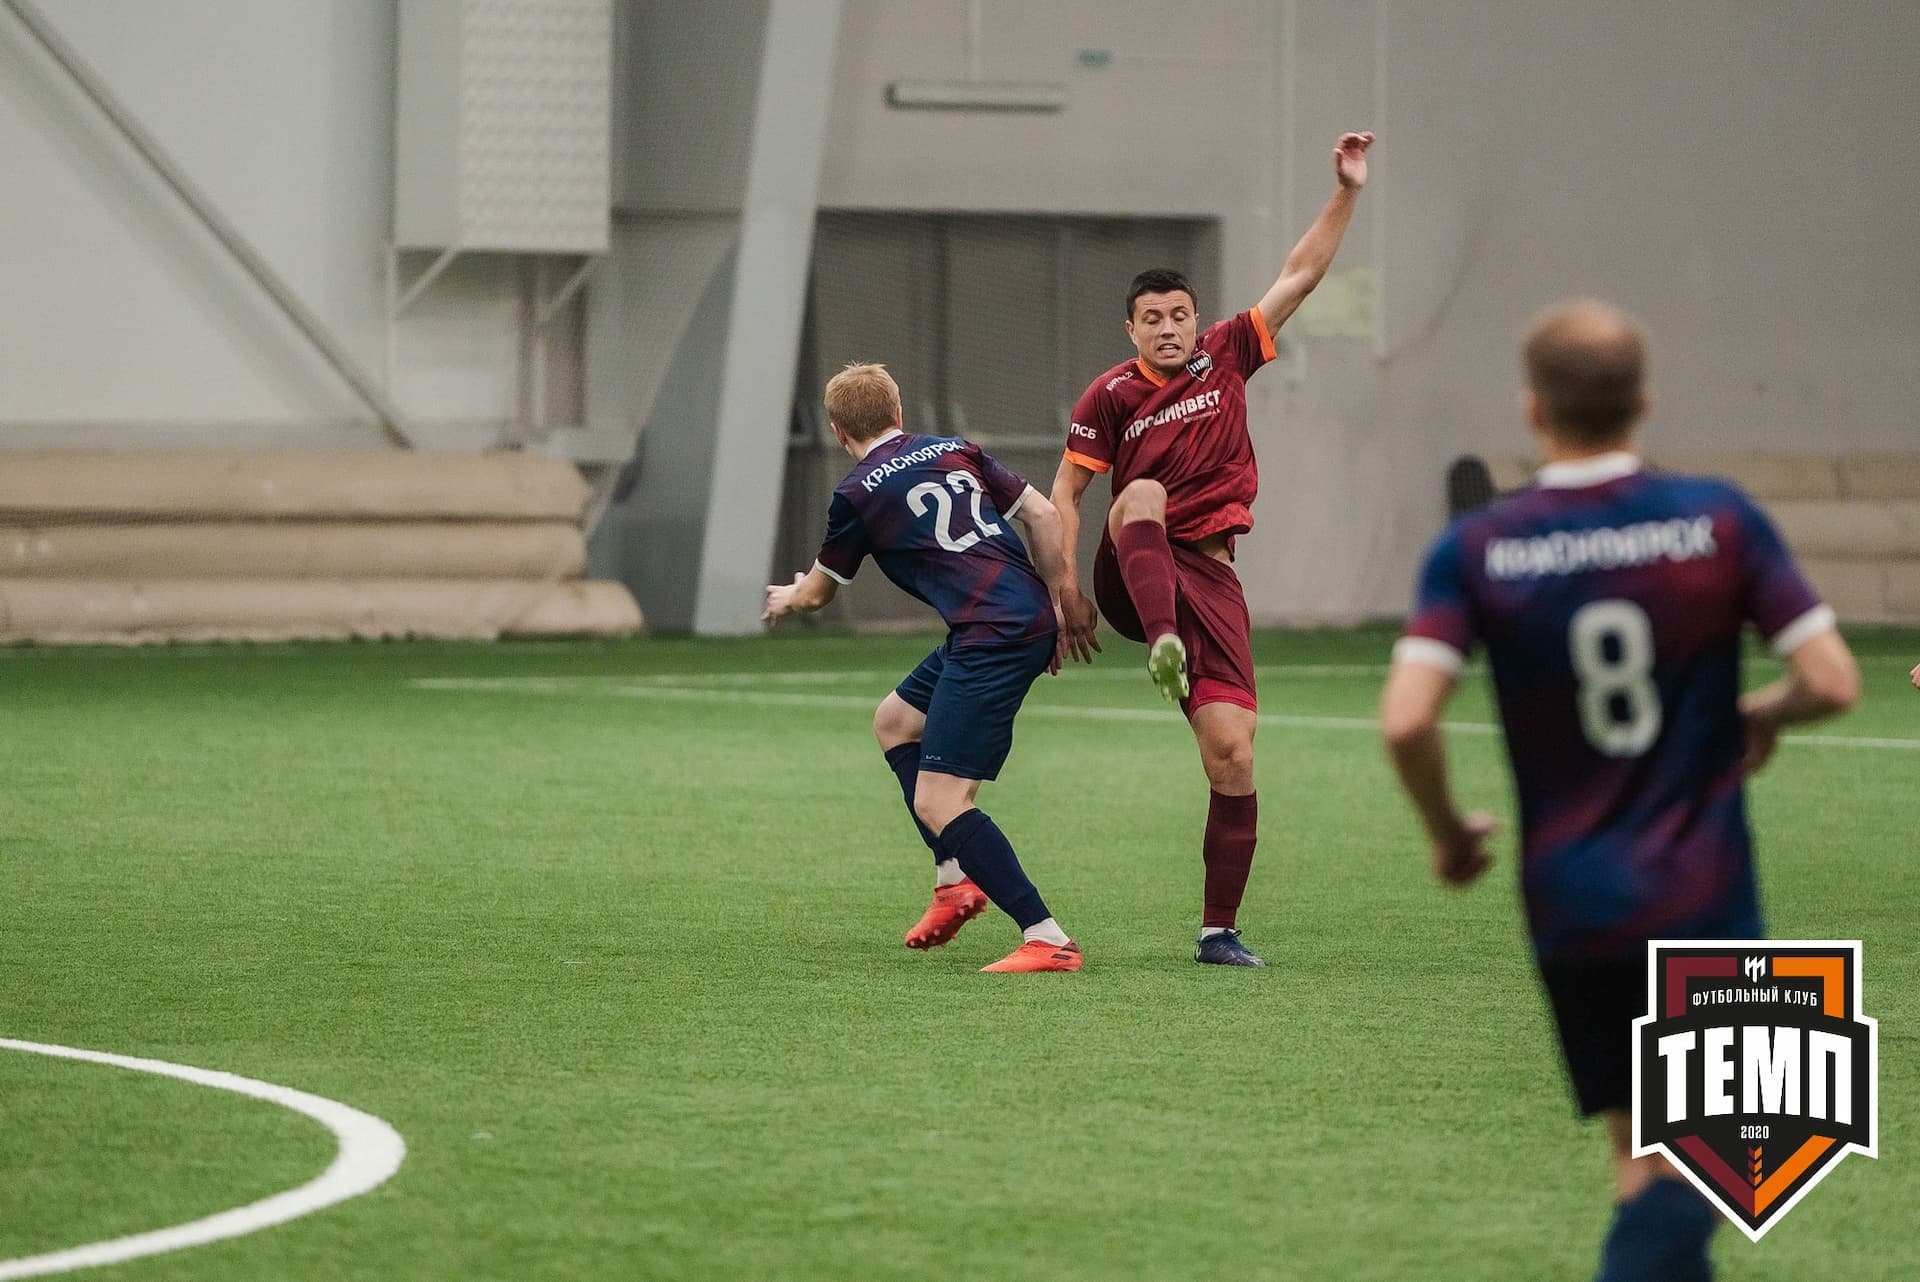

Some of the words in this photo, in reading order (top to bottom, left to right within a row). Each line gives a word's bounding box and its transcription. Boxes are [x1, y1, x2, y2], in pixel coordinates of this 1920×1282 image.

[1070, 422, 1097, 440] ПСБ
[1124, 389, 1221, 442] ПРОДИНВЕСТ
[861, 441, 966, 493] КРАСНОЯРСК
[906, 469, 1003, 553] 22
[1567, 598, 1663, 758] 8
